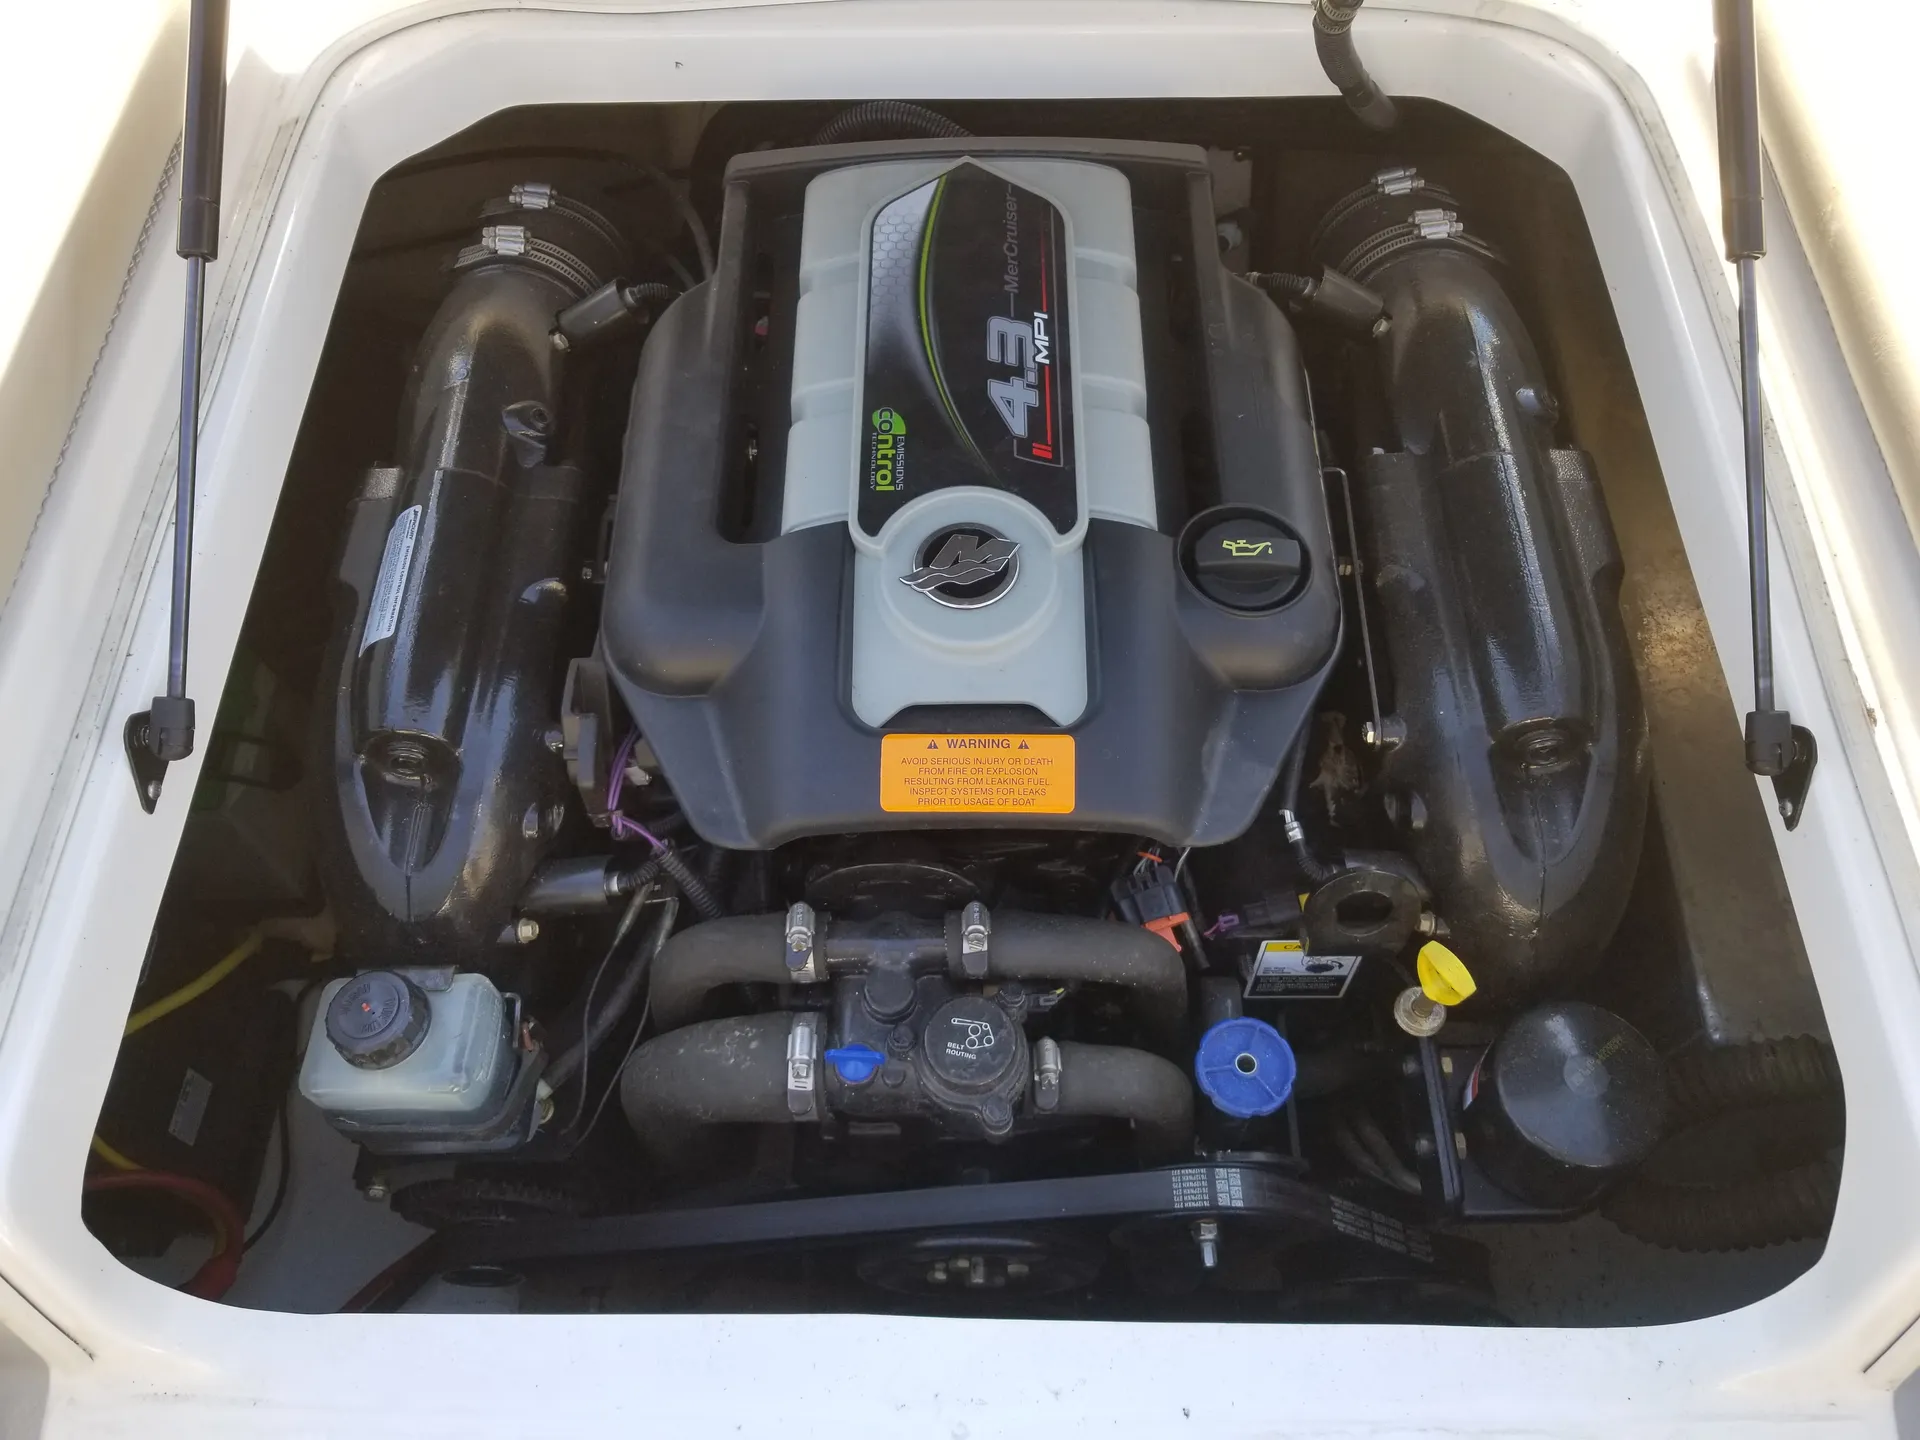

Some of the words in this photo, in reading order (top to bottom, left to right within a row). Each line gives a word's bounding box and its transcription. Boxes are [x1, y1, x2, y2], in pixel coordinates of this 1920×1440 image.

[1003, 196, 1019, 294] MerCruiser
[1033, 311, 1050, 365] MPI
[987, 316, 1038, 438] 4.3
[870, 432, 878, 491] TECHNOLOGY
[895, 435, 905, 491] EMISSIONS
[946, 738, 1011, 749] WARNING
[901, 757, 928, 765] AVOID
[930, 757, 971, 765] SERIOUS
[973, 757, 1005, 765] INJURY
[1007, 757, 1021, 766] OR
[1023, 758, 1053, 766] DEATH
[918, 767, 945, 775] FROM
[947, 767, 968, 775] FIRE
[970, 767, 984, 775] OR
[986, 767, 1038, 775] EXPLOSION
[904, 777, 954, 785] RESULTING
[957, 777, 984, 785] FROM
[985, 777, 1025, 785] LEAKING
[909, 787, 949, 795] INSPECT
[950, 787, 994, 796] SYSTEMS
[996, 787, 1015, 796] FOR
[1017, 788, 1047, 796] LEAKS
[917, 797, 946, 806] PRIOR
[949, 797, 961, 806] TO
[963, 797, 995, 806] USAGE
[997, 797, 1010, 806] OF
[1012, 797, 1036, 806] BOAT
[947, 1041, 965, 1050] BELT
[945, 1049, 977, 1059] ROUTING
